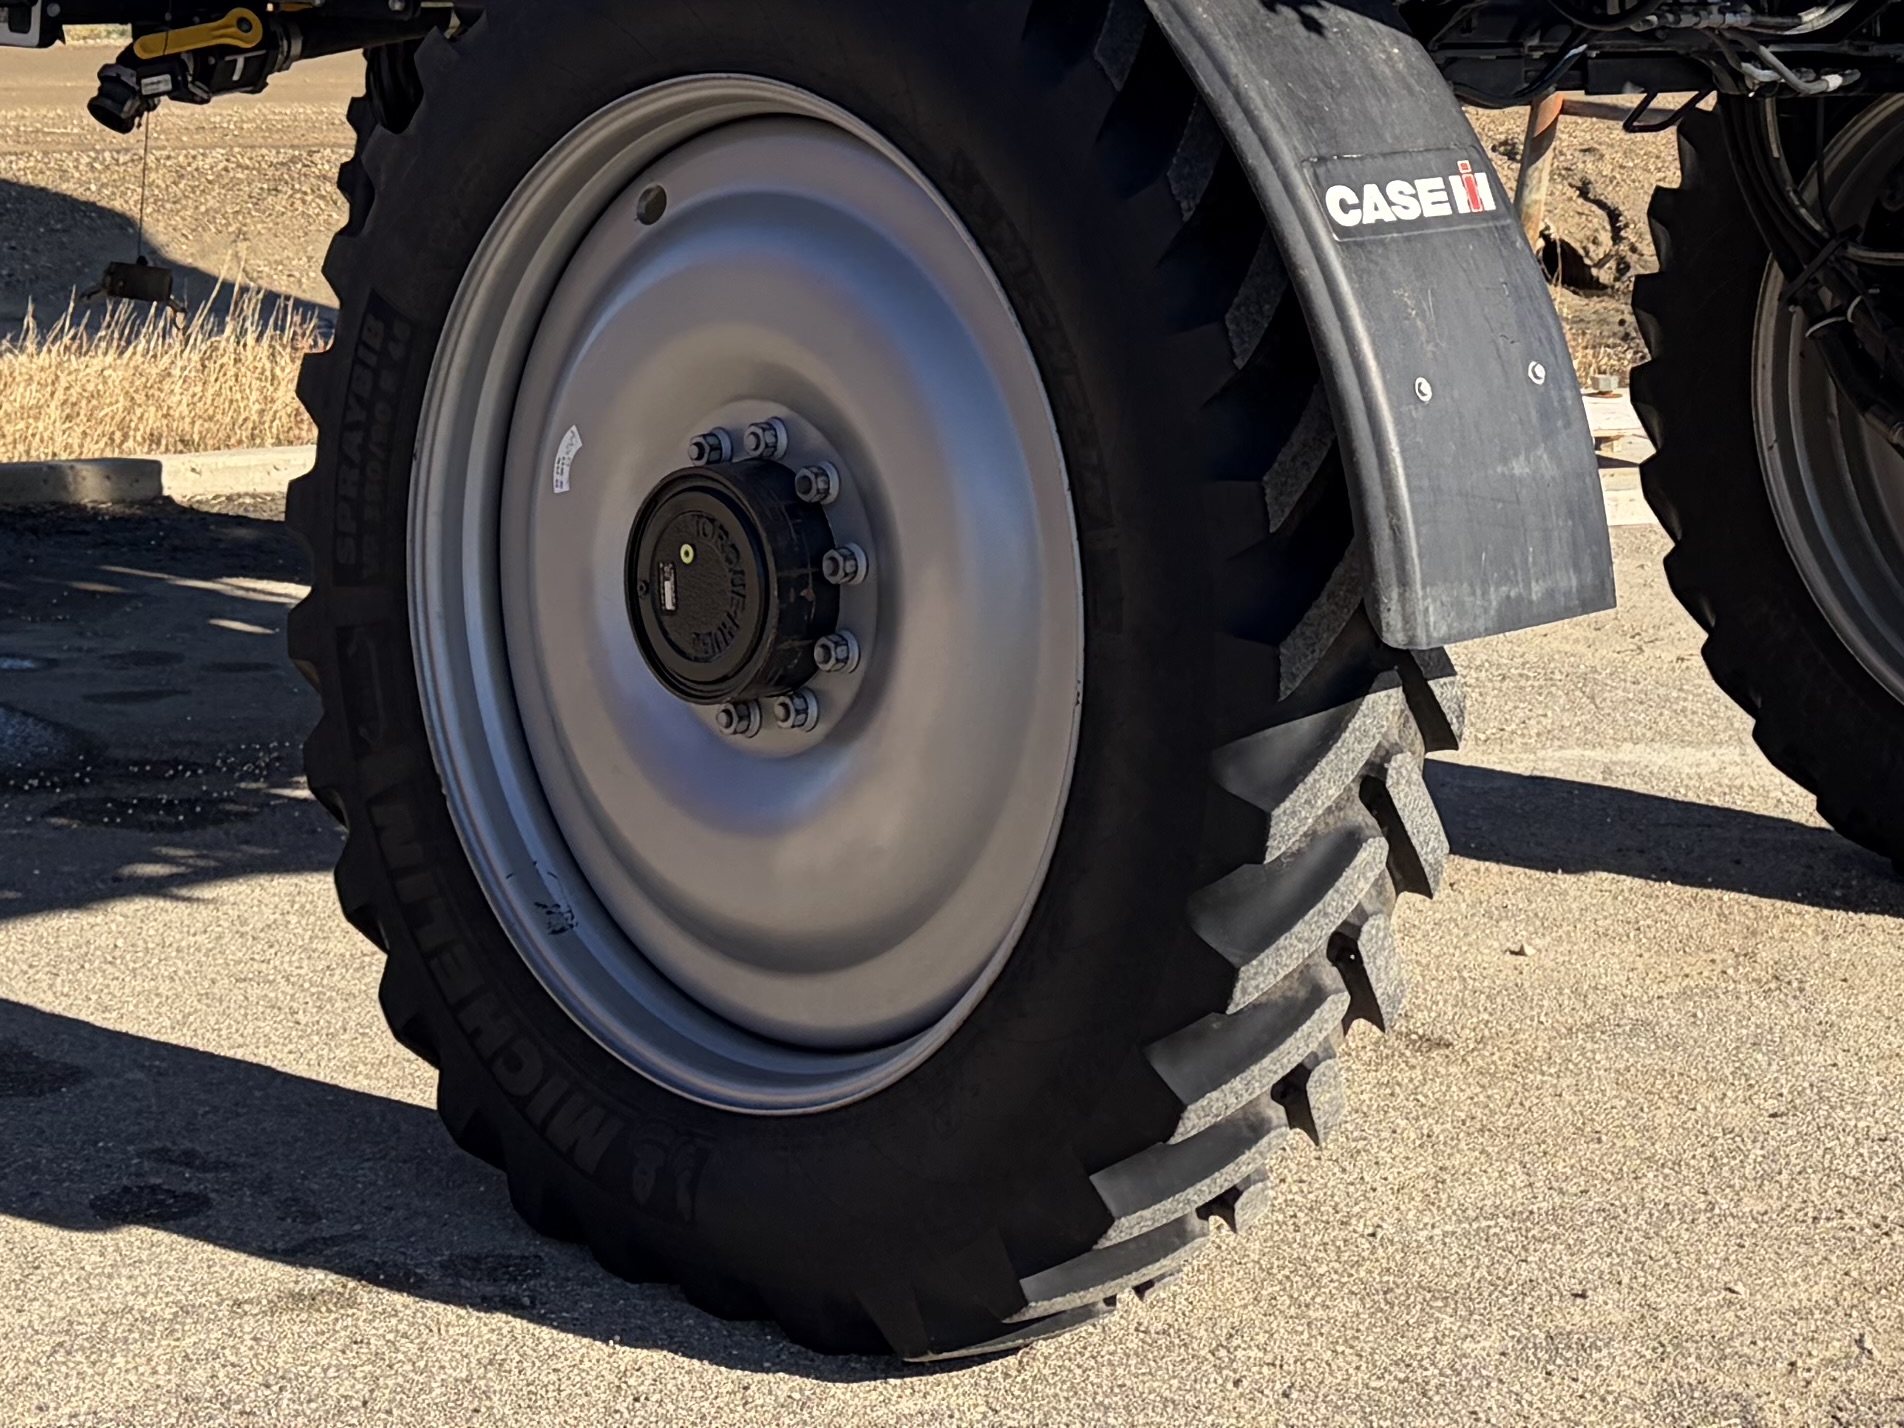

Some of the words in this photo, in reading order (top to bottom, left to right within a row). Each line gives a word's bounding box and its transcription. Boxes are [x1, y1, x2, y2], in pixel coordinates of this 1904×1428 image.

[1325, 176, 1453, 227] CASE
[335, 312, 384, 565] SPRAYBIB
[370, 801, 627, 1175] MICHELIN
